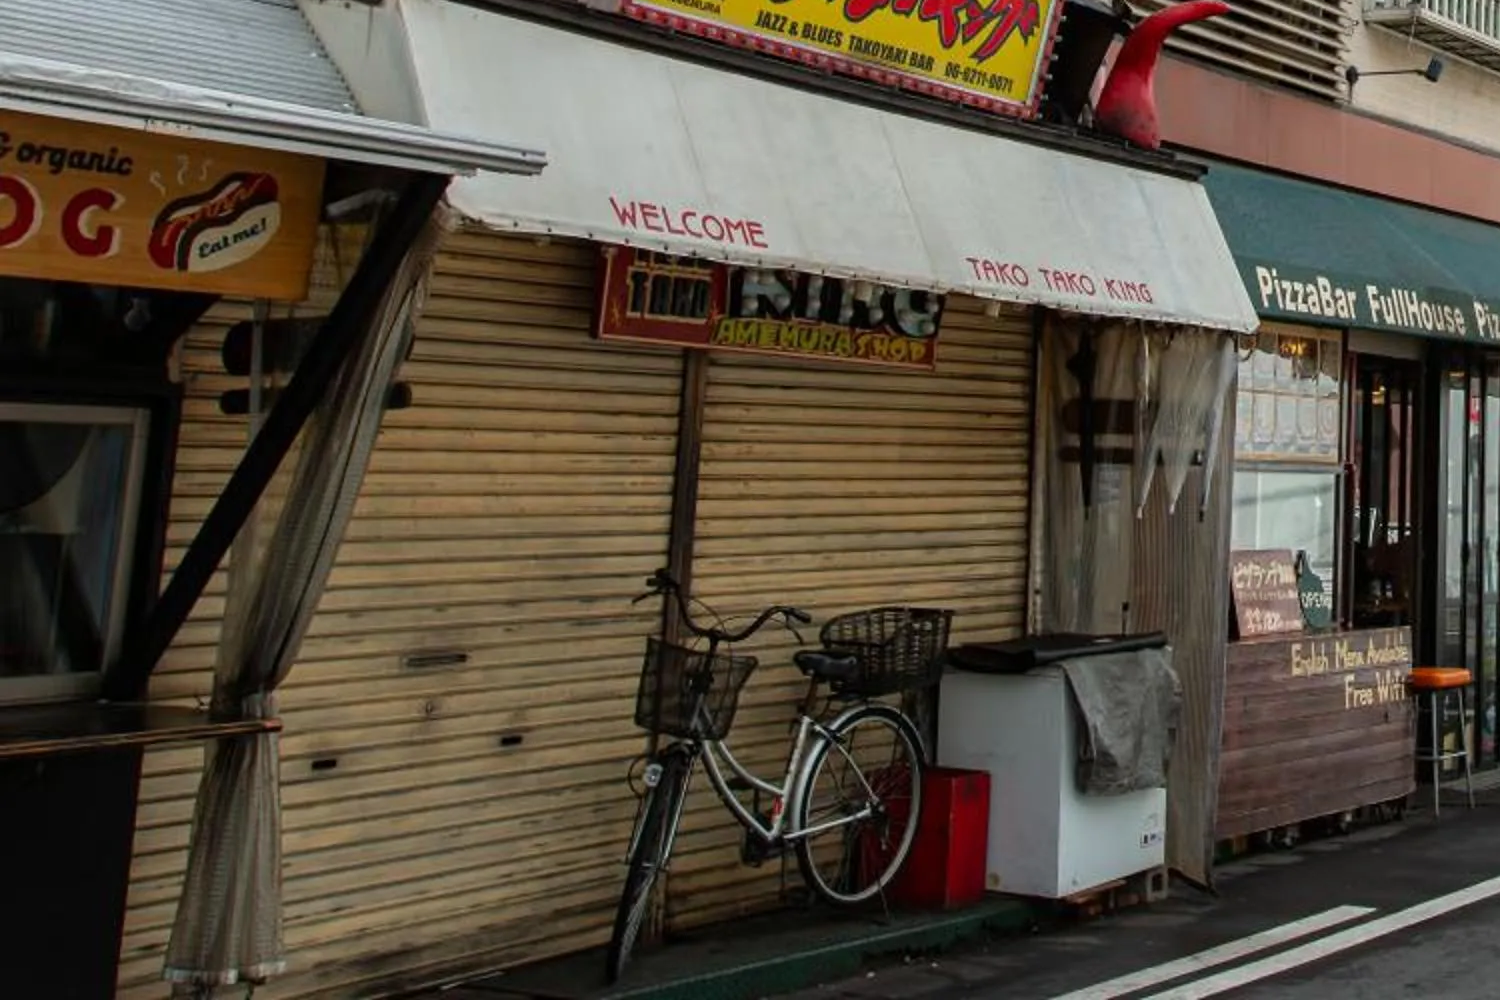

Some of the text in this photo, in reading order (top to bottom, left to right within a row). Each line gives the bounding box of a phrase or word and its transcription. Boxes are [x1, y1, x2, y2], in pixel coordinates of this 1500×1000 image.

[756, 9, 936, 72] JAZZ & BLUES TAKOYAKI BAR
[16, 146, 134, 176] organic
[199, 217, 267, 259] Eat me!
[610, 197, 768, 248] WELCOME
[966, 257, 1154, 305] TAKO TAKO KING
[1256, 266, 1357, 320] PizzaBar
[1366, 284, 1466, 336] FullHouse
[714, 319, 927, 362] AMEMURA SHOP
[1291, 642, 1328, 677] English
[1336, 639, 1364, 670] Menu
[1344, 673, 1373, 709] Free
